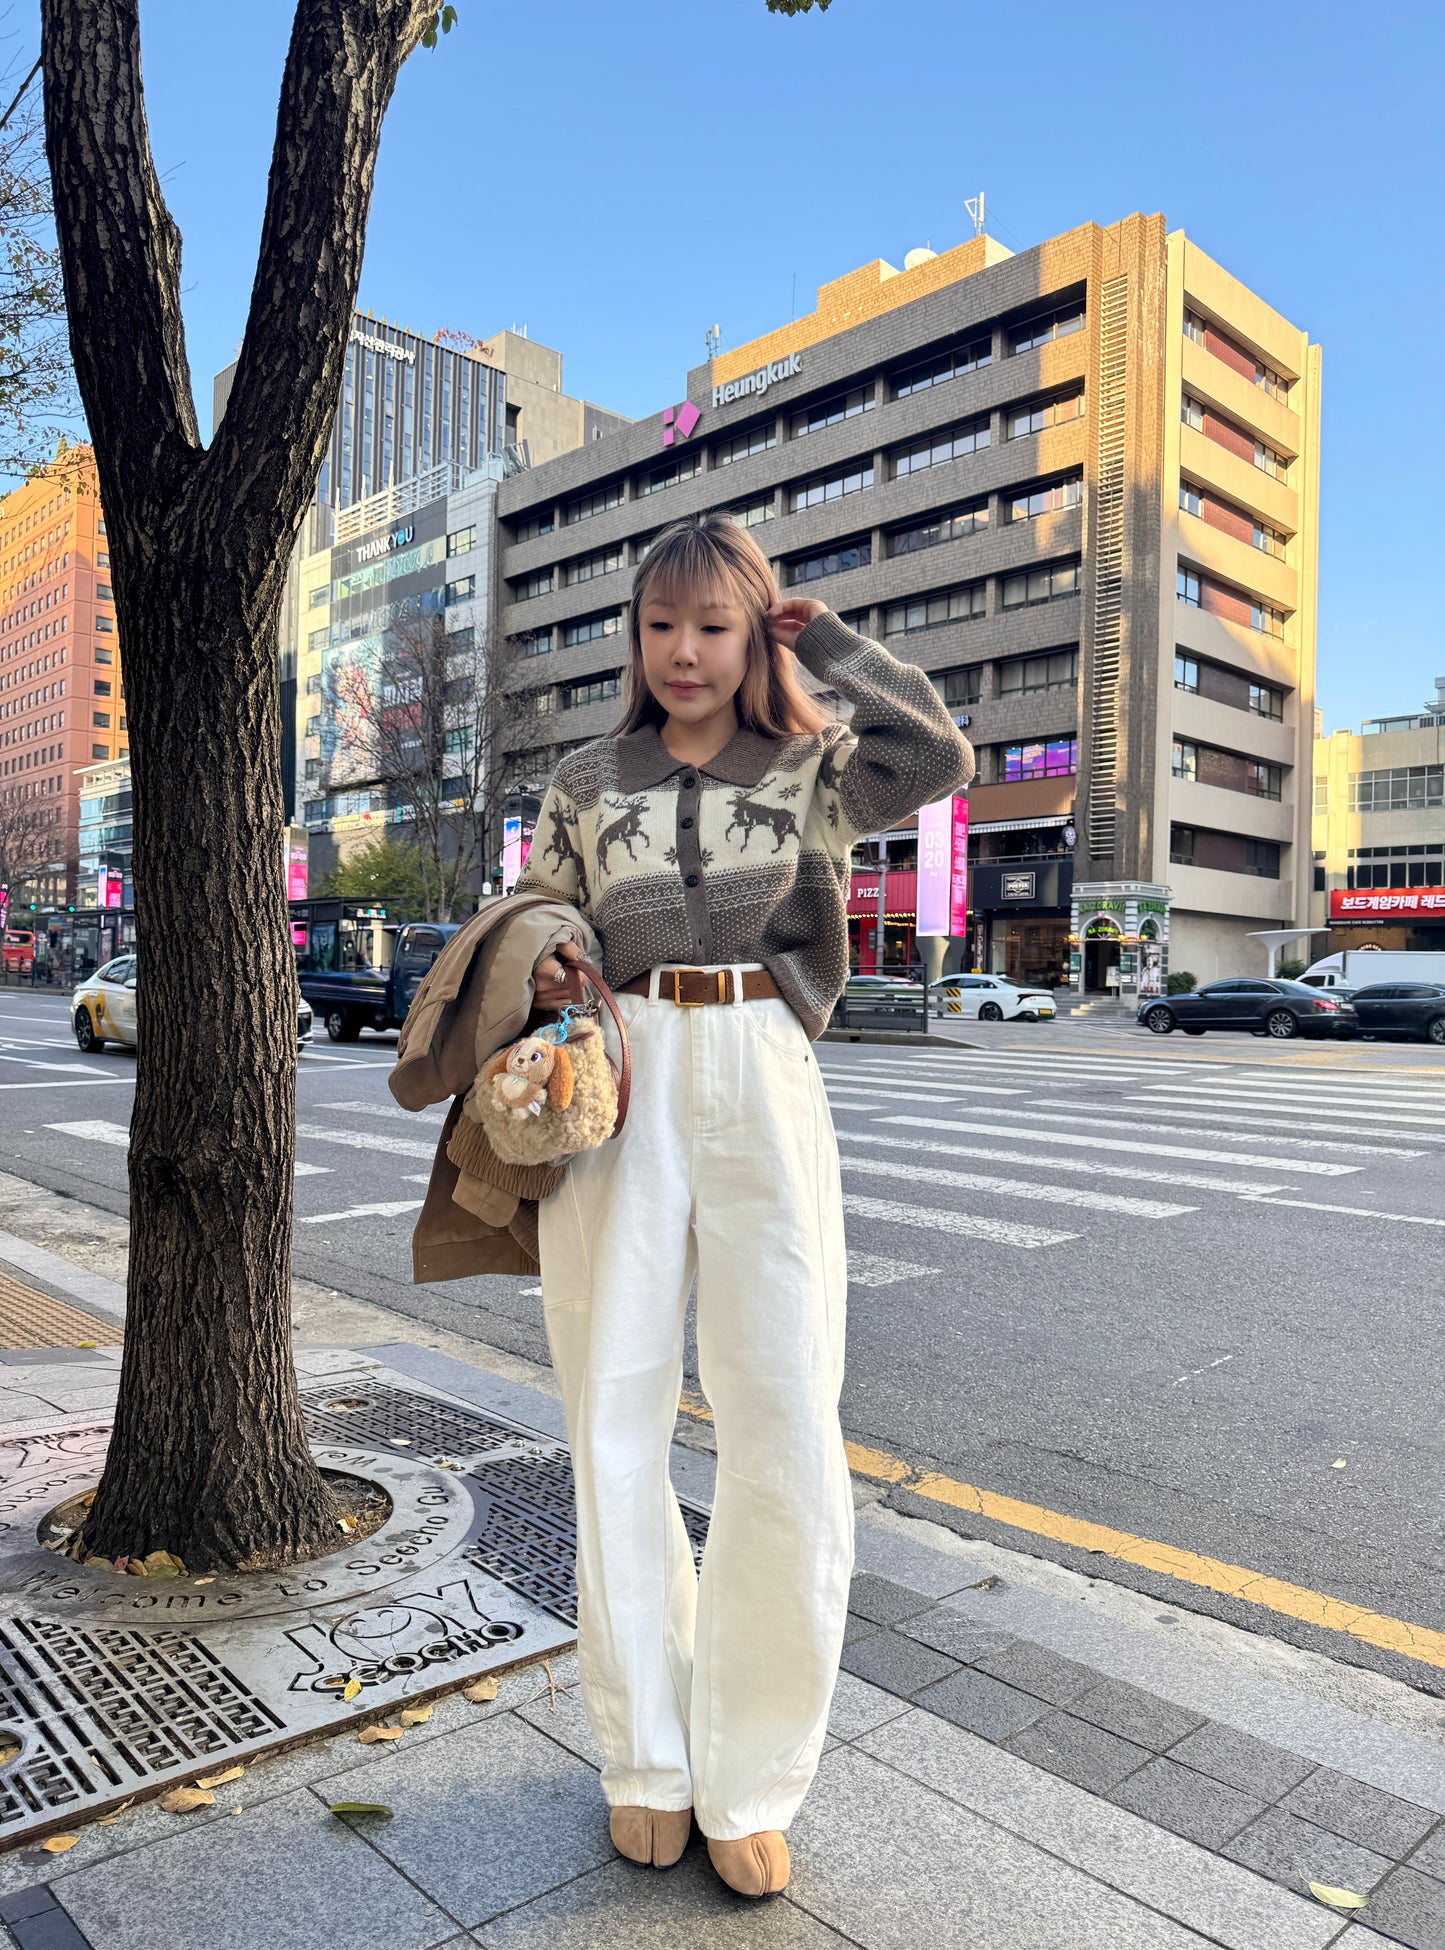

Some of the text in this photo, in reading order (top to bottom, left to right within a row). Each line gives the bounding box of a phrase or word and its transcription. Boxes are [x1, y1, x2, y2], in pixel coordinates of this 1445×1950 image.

[350, 329, 416, 365] 자산관리공사
[712, 353, 802, 408] Heungkuk
[356, 525, 413, 563] THANK YOU
[924, 831, 945, 849] 03
[924, 850, 945, 868] 20
[857, 887, 887, 898] PIZZ
[1341, 895, 1418, 910] 보드게임카페
[20, 1485, 449, 1609] Welcome to Seocho Gu
